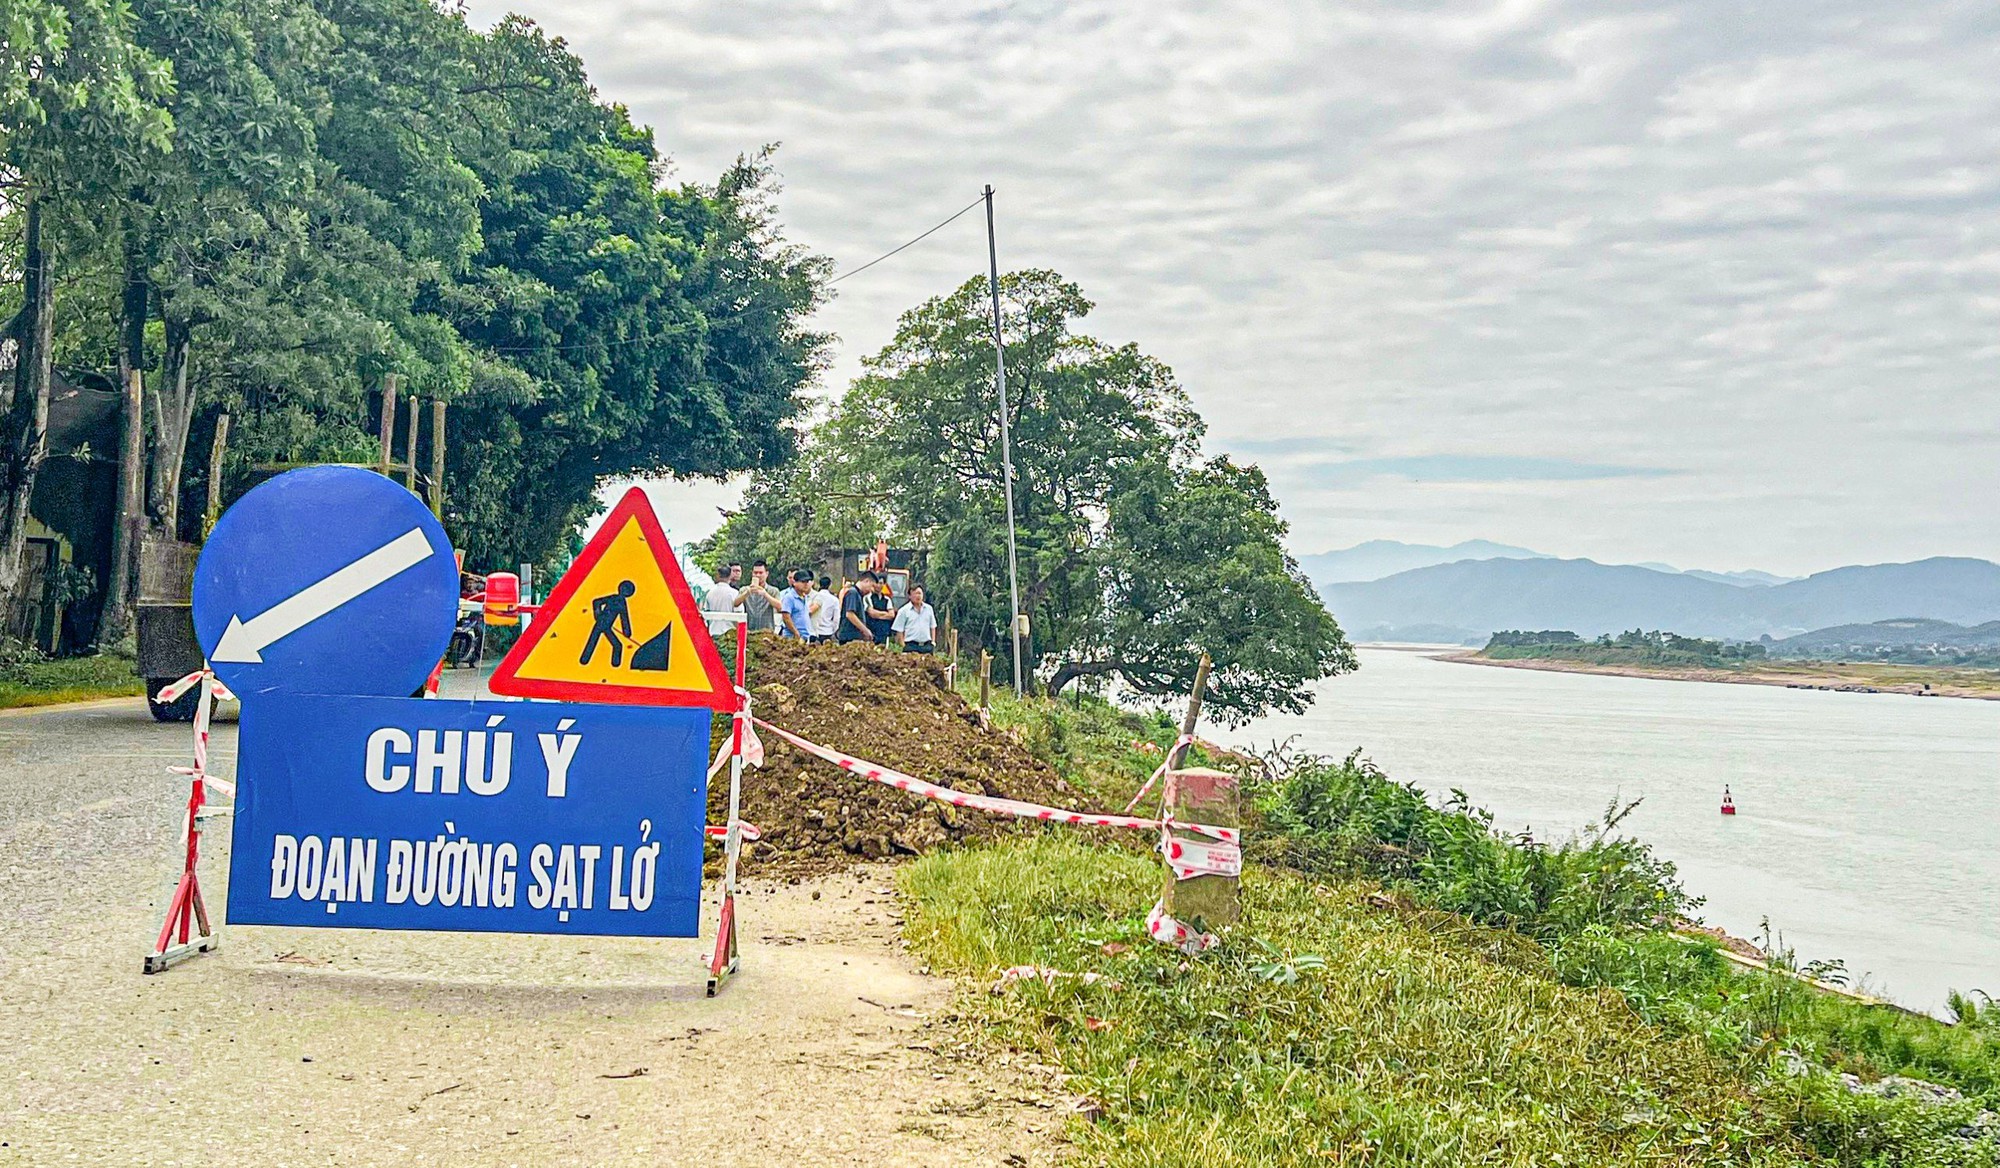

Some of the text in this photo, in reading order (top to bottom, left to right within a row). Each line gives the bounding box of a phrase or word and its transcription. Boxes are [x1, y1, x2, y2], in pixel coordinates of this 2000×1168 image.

[365, 714, 583, 798] CHÚ Ý
[270, 818, 661, 923] ĐOẠN ĐƯỜNG SẠT LỞ
